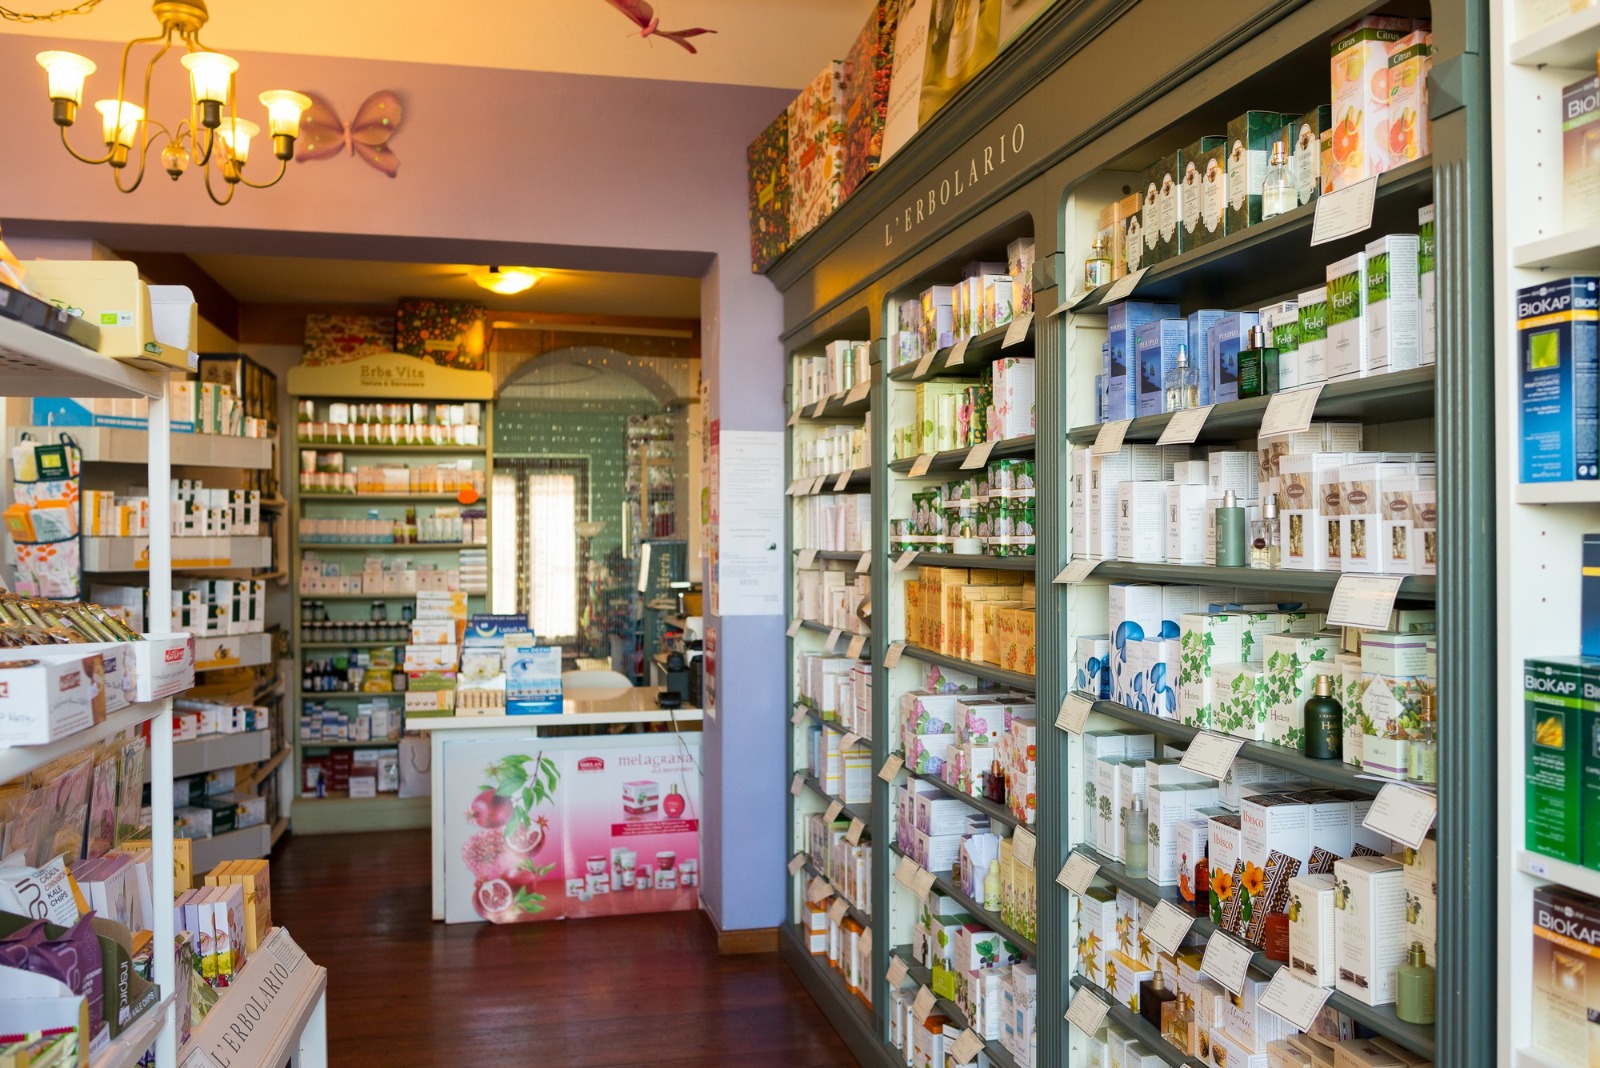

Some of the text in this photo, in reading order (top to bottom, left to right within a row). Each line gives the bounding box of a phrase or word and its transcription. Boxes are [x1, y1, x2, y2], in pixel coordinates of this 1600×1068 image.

[1376, 30, 1400, 40] Citrus
[1337, 36, 1356, 51] Citrus
[1393, 50, 1412, 64] Citrus
[885, 123, 1025, 247] L'ERBOLARIO
[1368, 274, 1384, 288] Felci
[1333, 292, 1353, 309] Felci
[1304, 316, 1324, 331] Felci
[1277, 333, 1292, 345] Felci
[361, 365, 425, 378] Erba Vita
[1185, 689, 1200, 701] Hedera
[1270, 709, 1290, 723] Hedera
[1243, 809, 1265, 829] Ibisco
[1213, 832, 1234, 851] Ibisco
[47, 885, 63, 899] KALE
[50, 890, 69, 907] CHIPS
[210, 963, 289, 1068] L'ERBOLARIO
